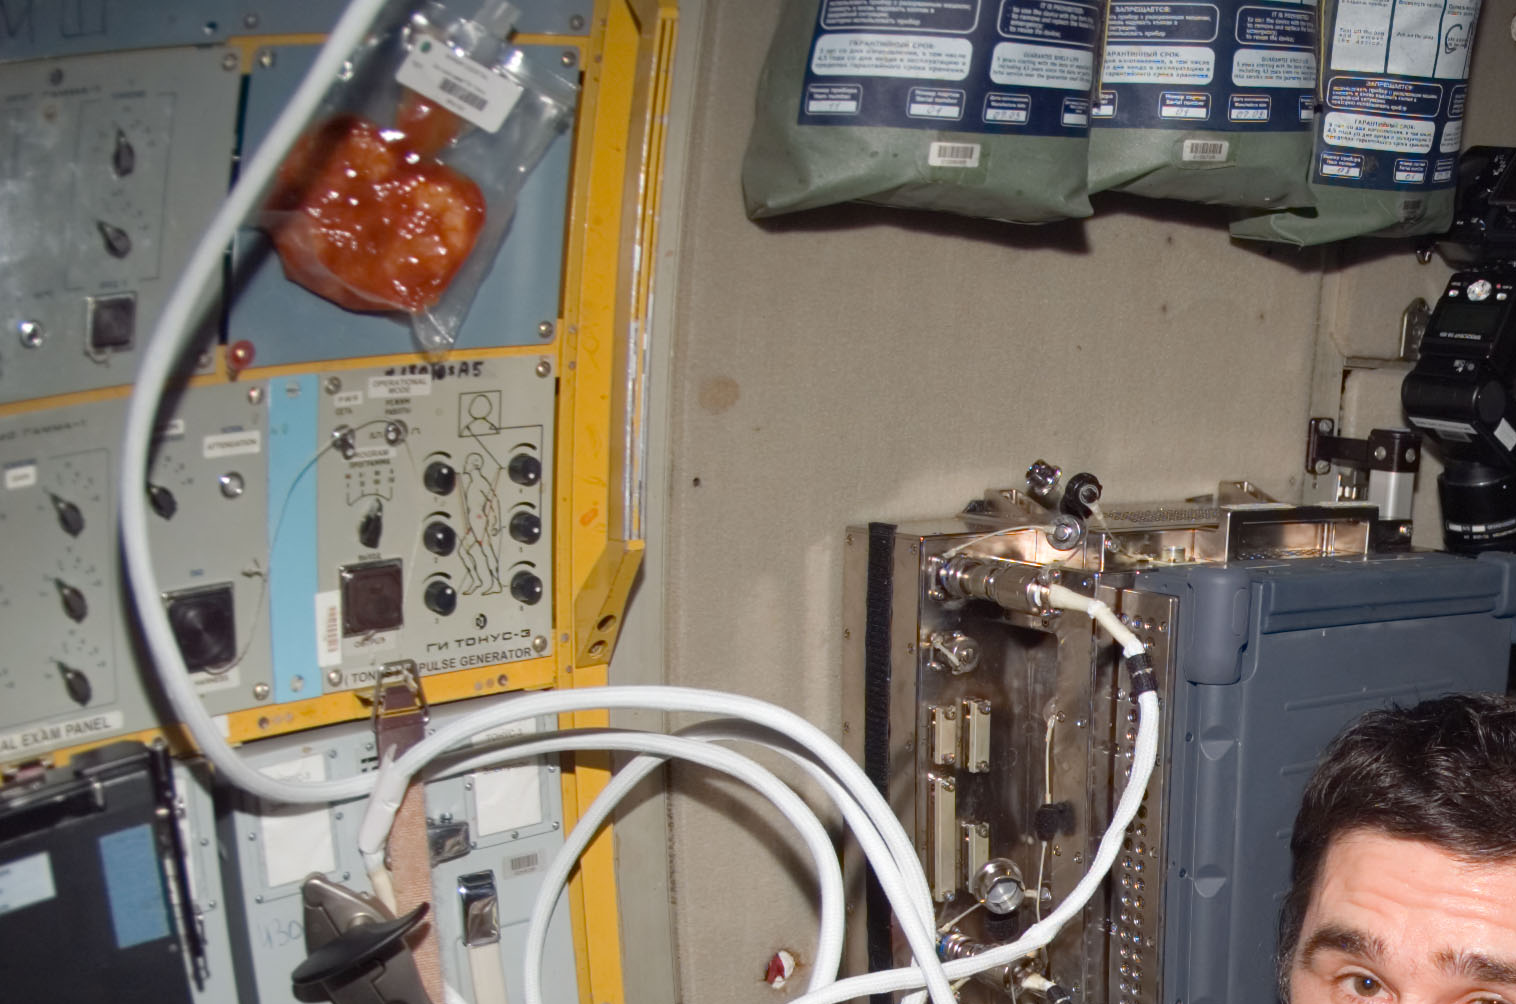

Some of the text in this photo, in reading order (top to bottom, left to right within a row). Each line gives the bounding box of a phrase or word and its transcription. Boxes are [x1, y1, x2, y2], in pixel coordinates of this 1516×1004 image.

[373, 377, 427, 389] OPERATIONAL
[388, 386, 411, 395] MODE
[455, 628, 531, 647] ТОНУС-3
[460, 648, 532, 667] GENERATOR
[22, 727, 61, 747] EXAM
[66, 718, 112, 738] PANEL
